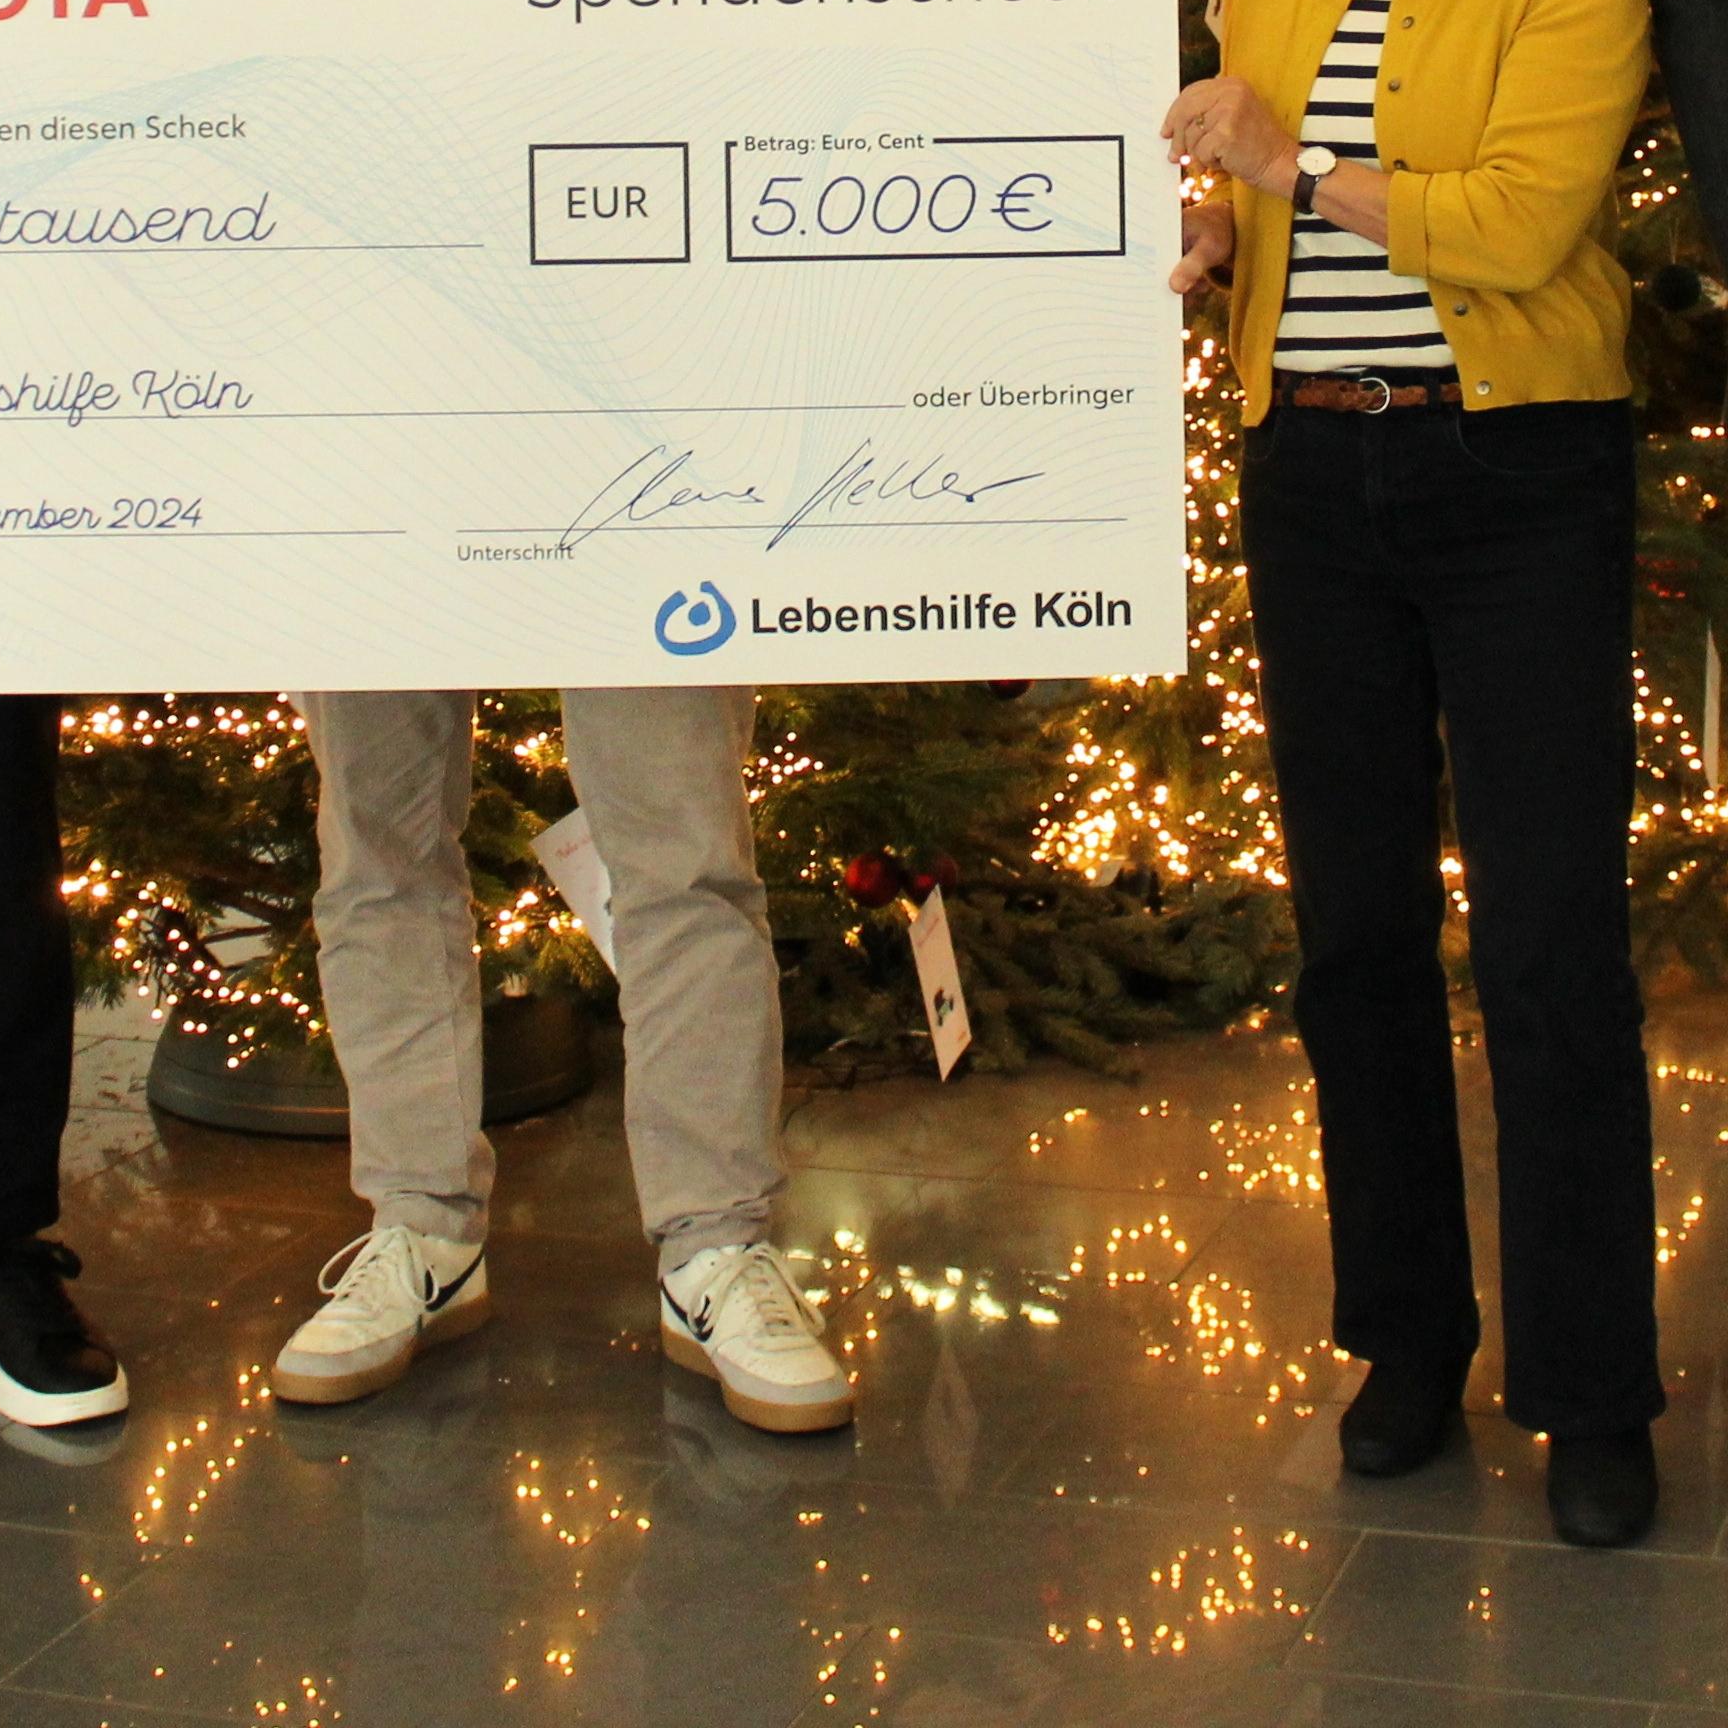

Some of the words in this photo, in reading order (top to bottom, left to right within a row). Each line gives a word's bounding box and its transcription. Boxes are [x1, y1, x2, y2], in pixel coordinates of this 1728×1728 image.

[41, 116, 135, 140] diesen
[146, 113, 246, 139] Scheck
[745, 135, 815, 155] Betrag:
[823, 134, 871, 152] Euro,
[878, 133, 924, 150] Cent
[568, 186, 648, 219] EUR
[752, 175, 976, 236] 5.000
[990, 173, 1052, 232] €
[132, 370, 254, 418] Köln
[913, 386, 972, 408] oder
[980, 381, 1134, 410] Überbringer
[107, 498, 202, 528] 2024
[457, 543, 574, 561] Unterschrift
[752, 592, 1016, 634] Lebenshilfe
[1034, 589, 1131, 629] Köln
